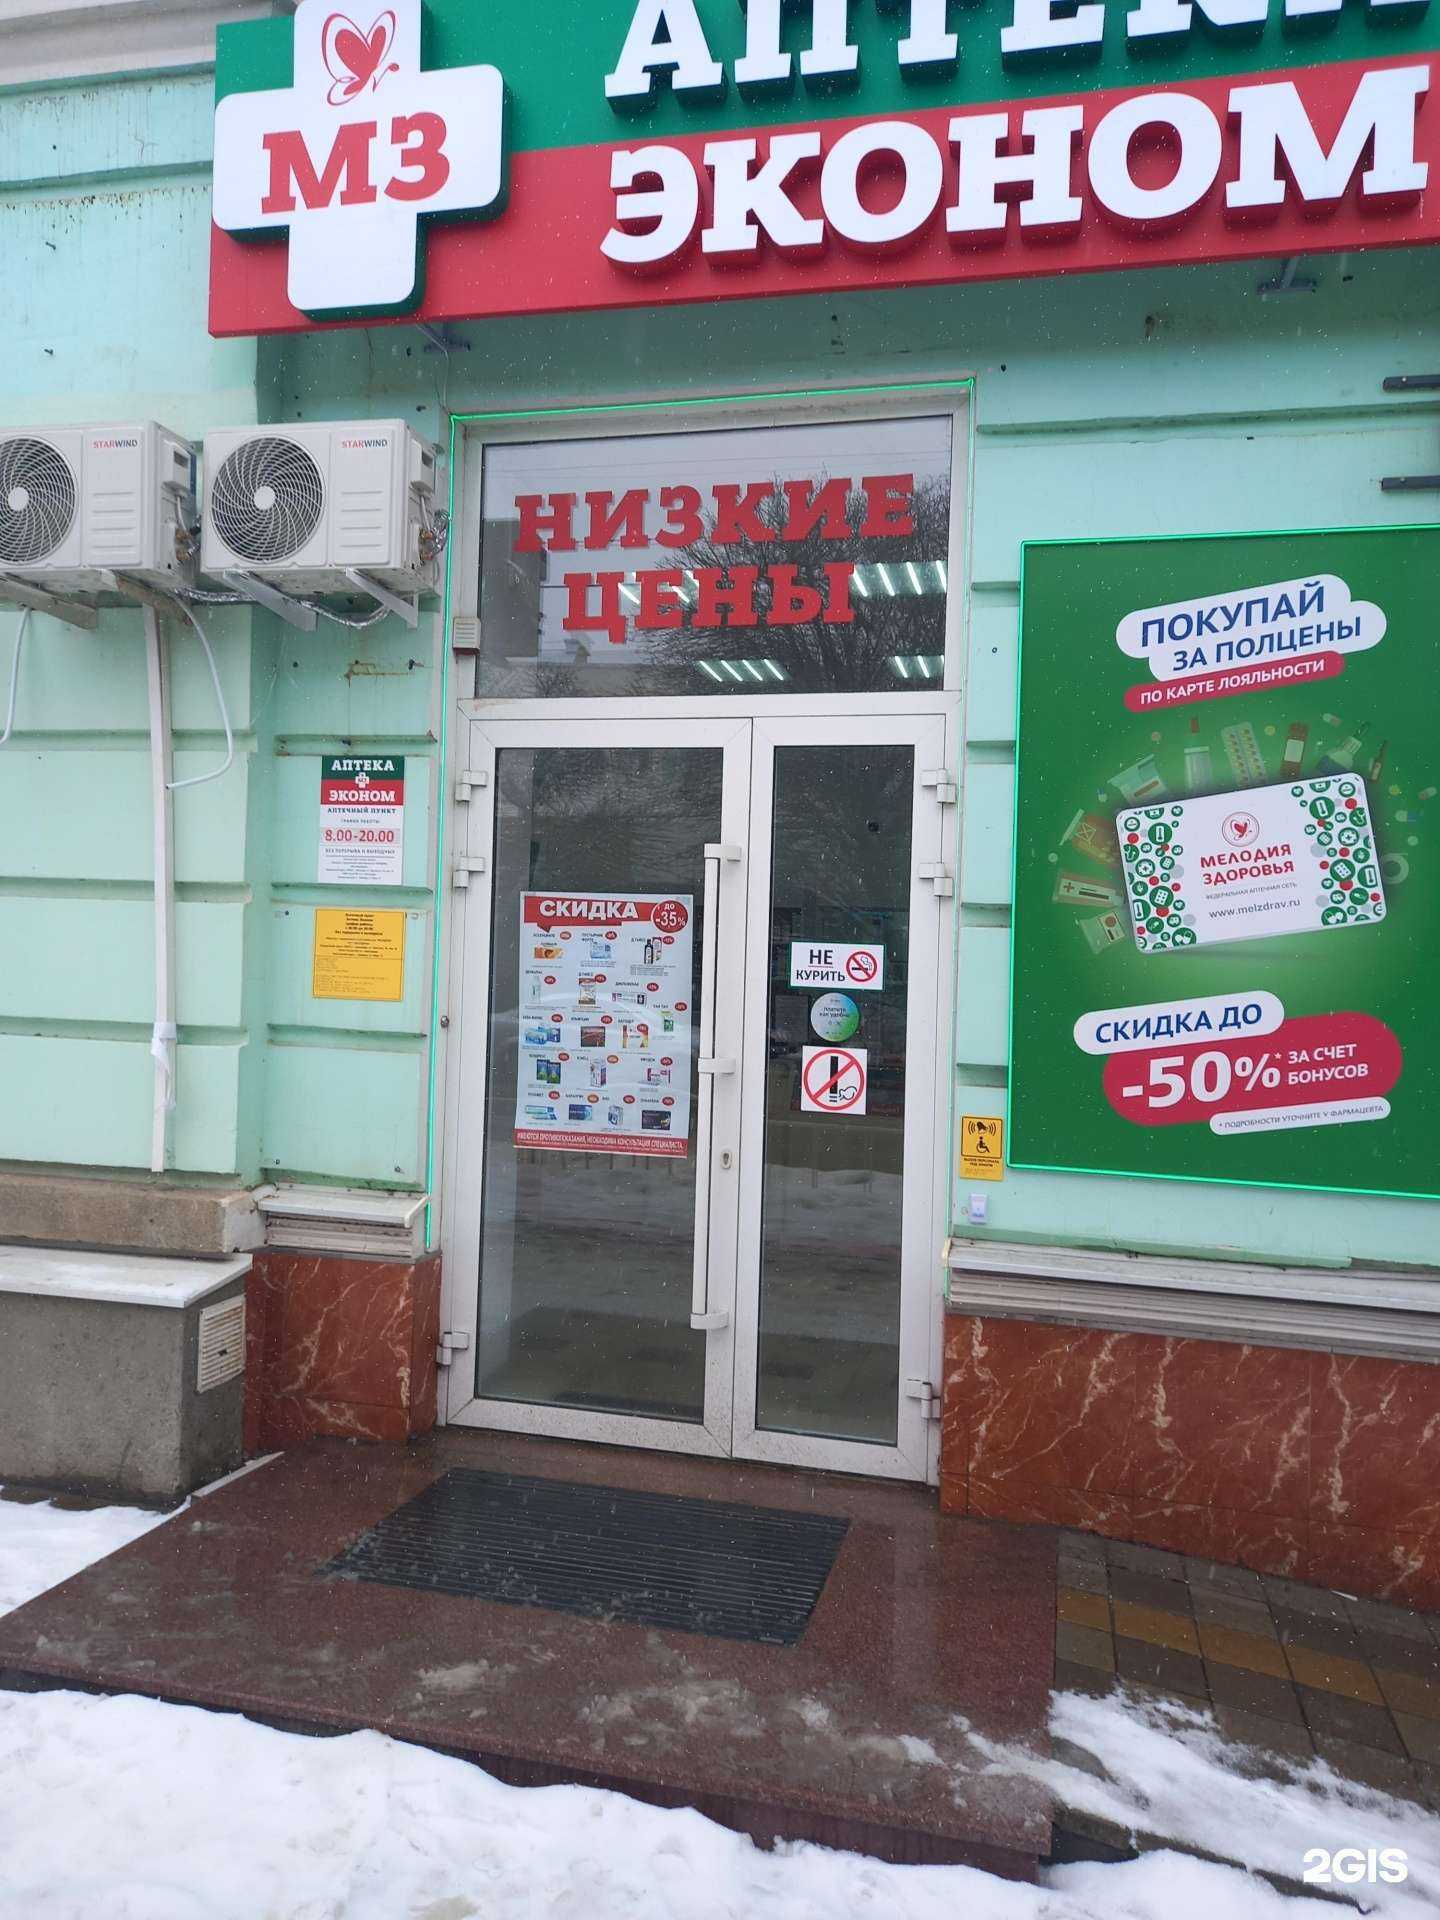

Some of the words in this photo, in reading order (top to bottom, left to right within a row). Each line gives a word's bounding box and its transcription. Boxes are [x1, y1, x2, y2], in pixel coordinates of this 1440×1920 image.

[261, 111, 451, 215] МЗ
[600, 65, 1430, 264] ЭКОНОМ
[92, 438, 138, 449] STARWIND
[341, 438, 388, 449] STARWIND
[512, 473, 915, 553] НИЗКИЕ
[562, 561, 856, 644] ЦЕНЫ
[1141, 580, 1324, 648] ПОКУПАЙ
[1172, 647, 1208, 671] ЗА
[1215, 617, 1361, 663] ПОЛЦЕНЫ
[1140, 690, 1163, 705] ПО
[1166, 680, 1214, 700] КАРТЕ
[1217, 659, 1325, 690] ЛОЯЛЬНОСТИ
[331, 759, 395, 771] АПТЕКА
[328, 790, 396, 802] ЭКОНОМ
[327, 806, 369, 814] АПТЕЧНЫЙ
[1200, 843, 1292, 868] МЕЛОДИЯ
[1202, 861, 1295, 886] ЗДОРОВЬЯ
[540, 899, 639, 921] СКИДКА
[655, 911, 686, 926] -35%
[1209, 899, 1301, 919] www.melzdrav.ru
[808, 949, 834, 965] НЕ
[796, 969, 846, 982] КУРИТЬ
[1095, 1010, 1213, 1044] СКИДКА
[1218, 1003, 1262, 1031] ДО
[1288, 1050, 1310, 1064] ЗА
[1313, 1043, 1357, 1061] СЧЕТ
[1288, 1063, 1369, 1085] БОНУСОВ
[1224, 1116, 1281, 1128] ПОДРОБНОСТИ
[1282, 1112, 1321, 1122] УТОЧНИТЕ
[1330, 1105, 1384, 1117] ФАРМАЦЕВТА
